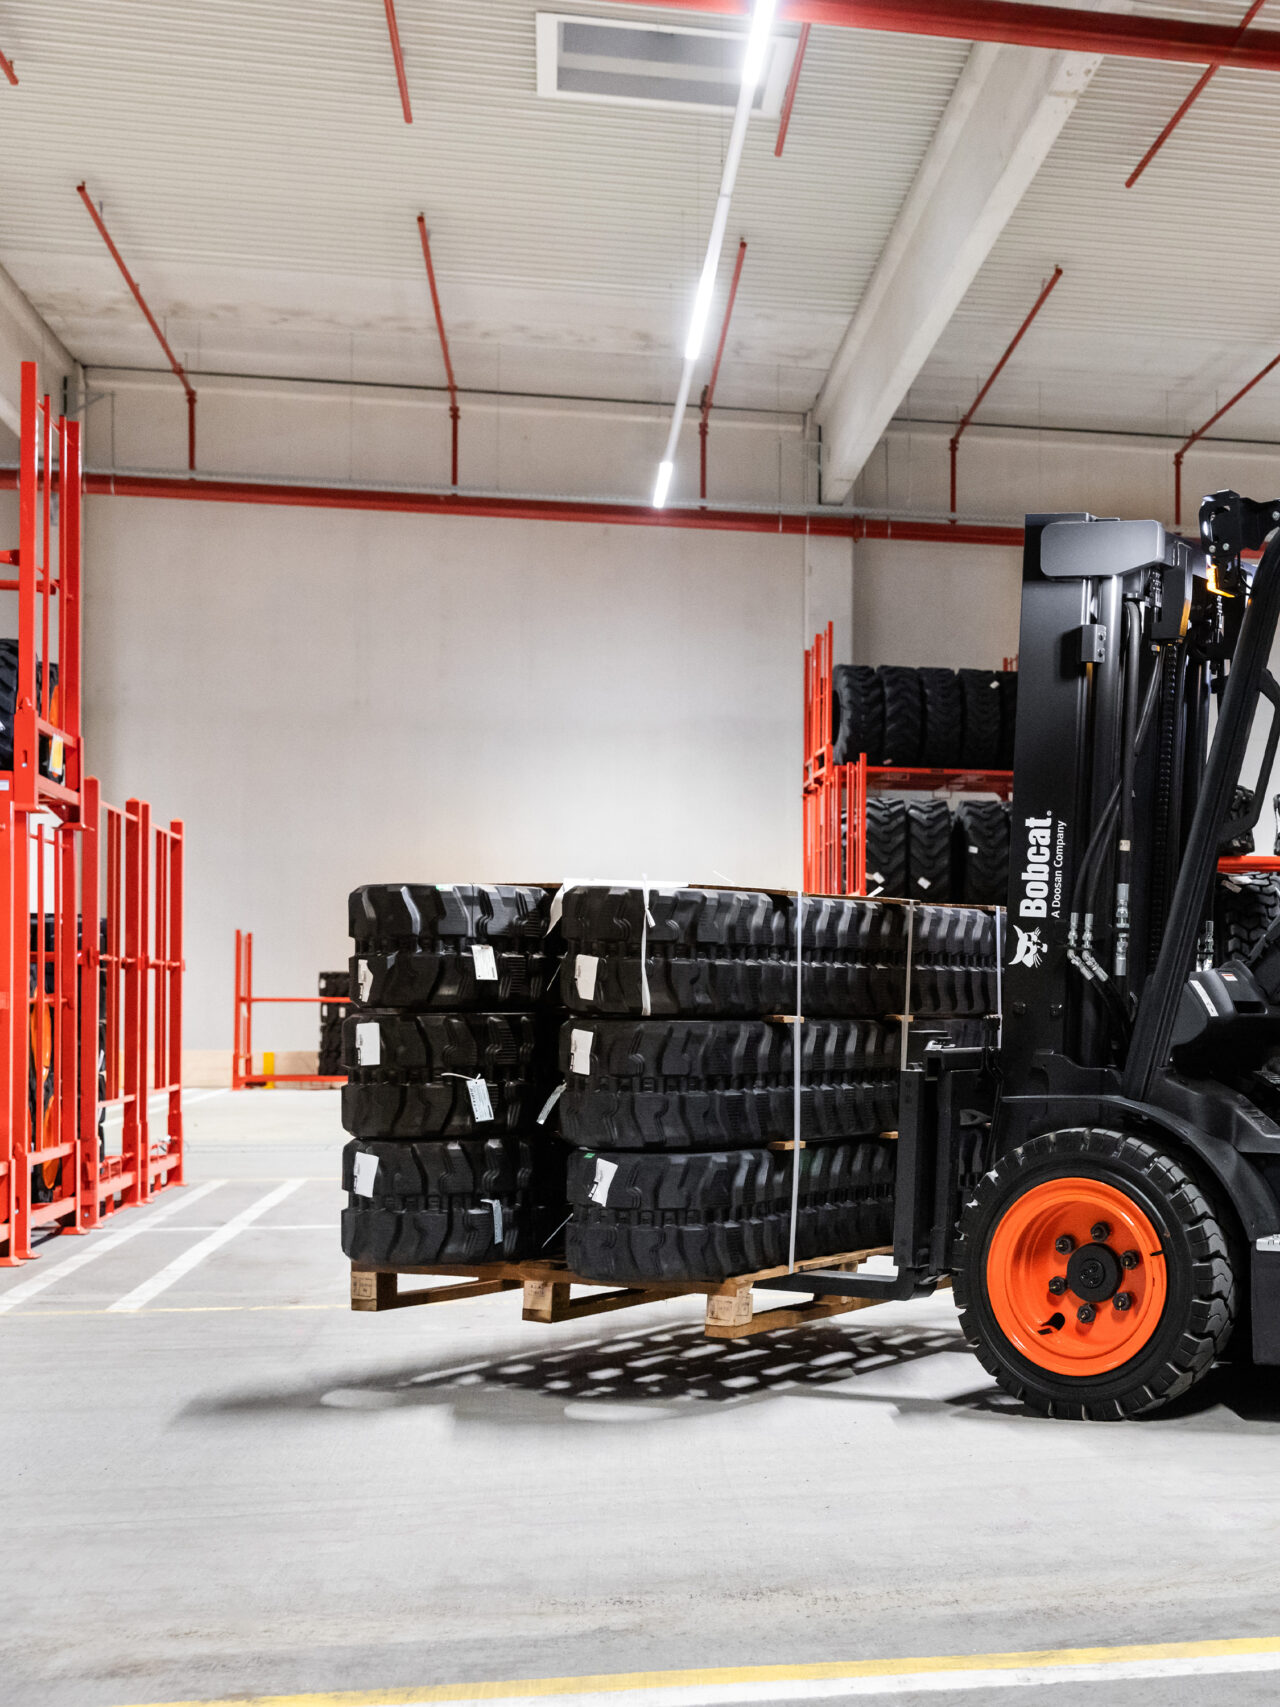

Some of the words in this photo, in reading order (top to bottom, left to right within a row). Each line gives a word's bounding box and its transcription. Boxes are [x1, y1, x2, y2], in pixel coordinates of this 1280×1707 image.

[1053, 820, 1067, 868] Company
[1019, 816, 1052, 918] Bobcat
[1052, 869, 1063, 908] Doosan
[1051, 910, 1060, 919] A
